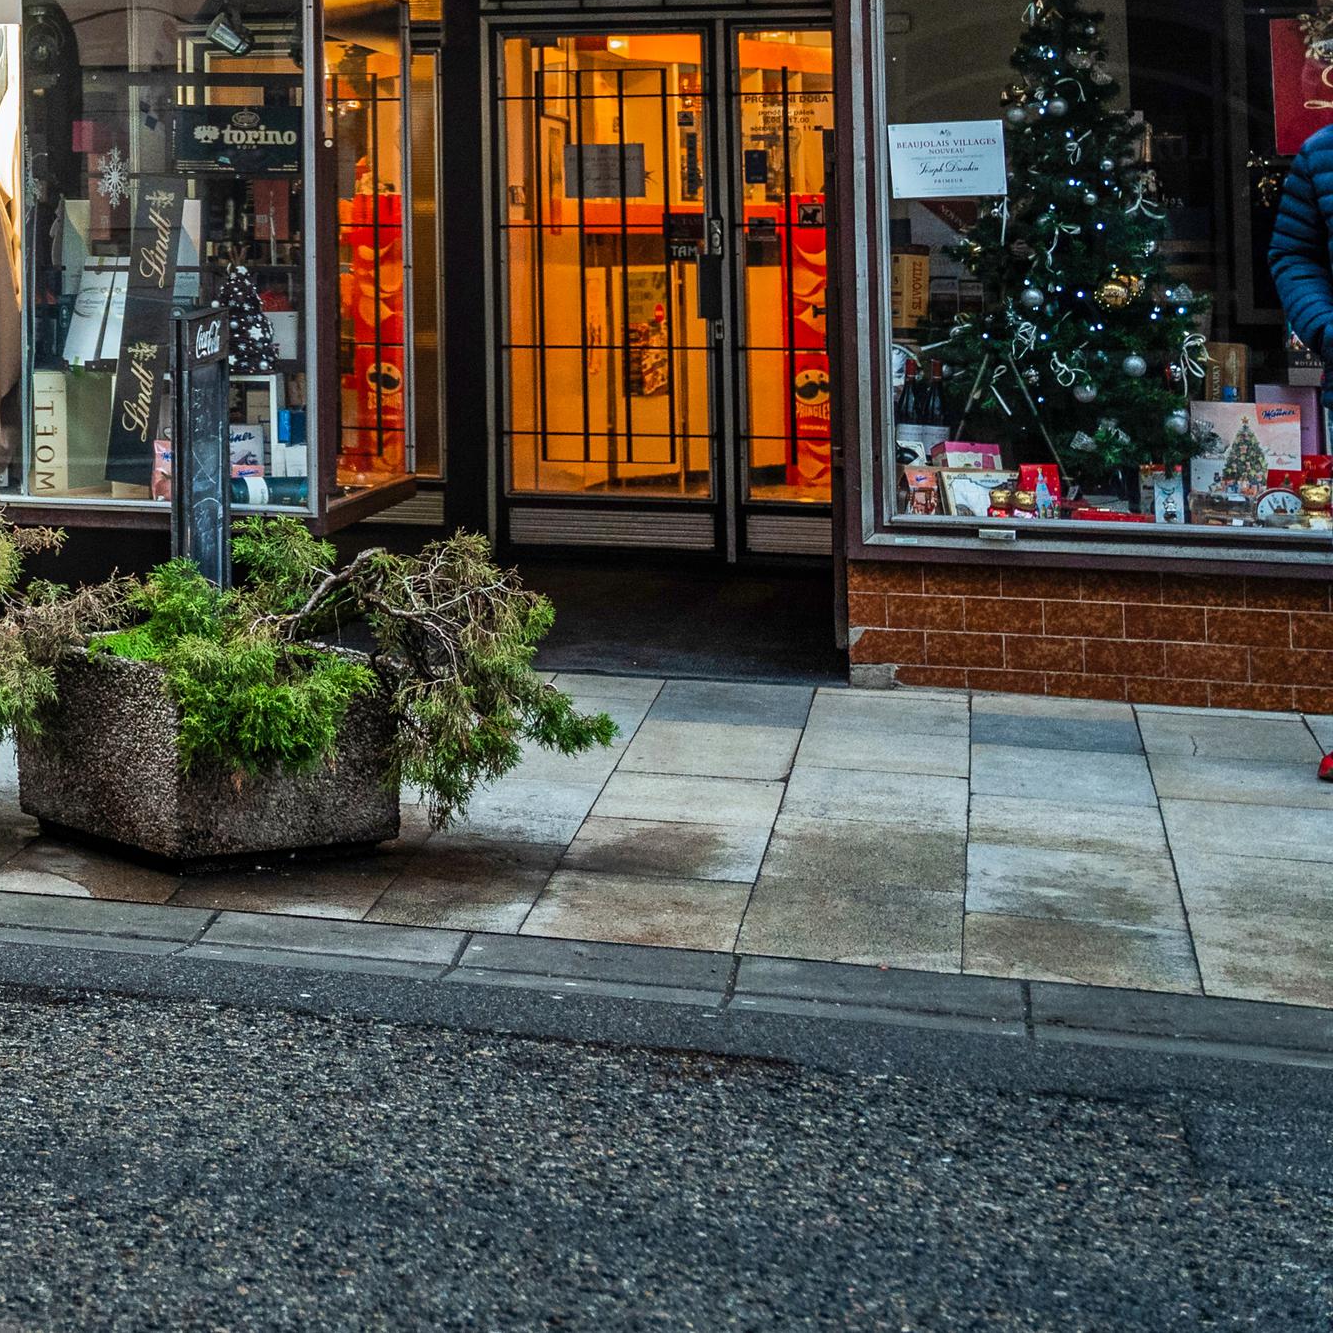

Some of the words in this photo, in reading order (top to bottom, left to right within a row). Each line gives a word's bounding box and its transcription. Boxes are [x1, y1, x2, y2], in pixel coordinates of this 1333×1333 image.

[799, 95, 829, 103] DOBA
[221, 124, 298, 145] torino
[896, 140, 950, 149] BEAUJOLAIS
[952, 138, 997, 147] VILLAGES
[139, 207, 172, 289] Lindt
[122, 358, 154, 443] Lindt
[34, 400, 58, 490] MOËT
